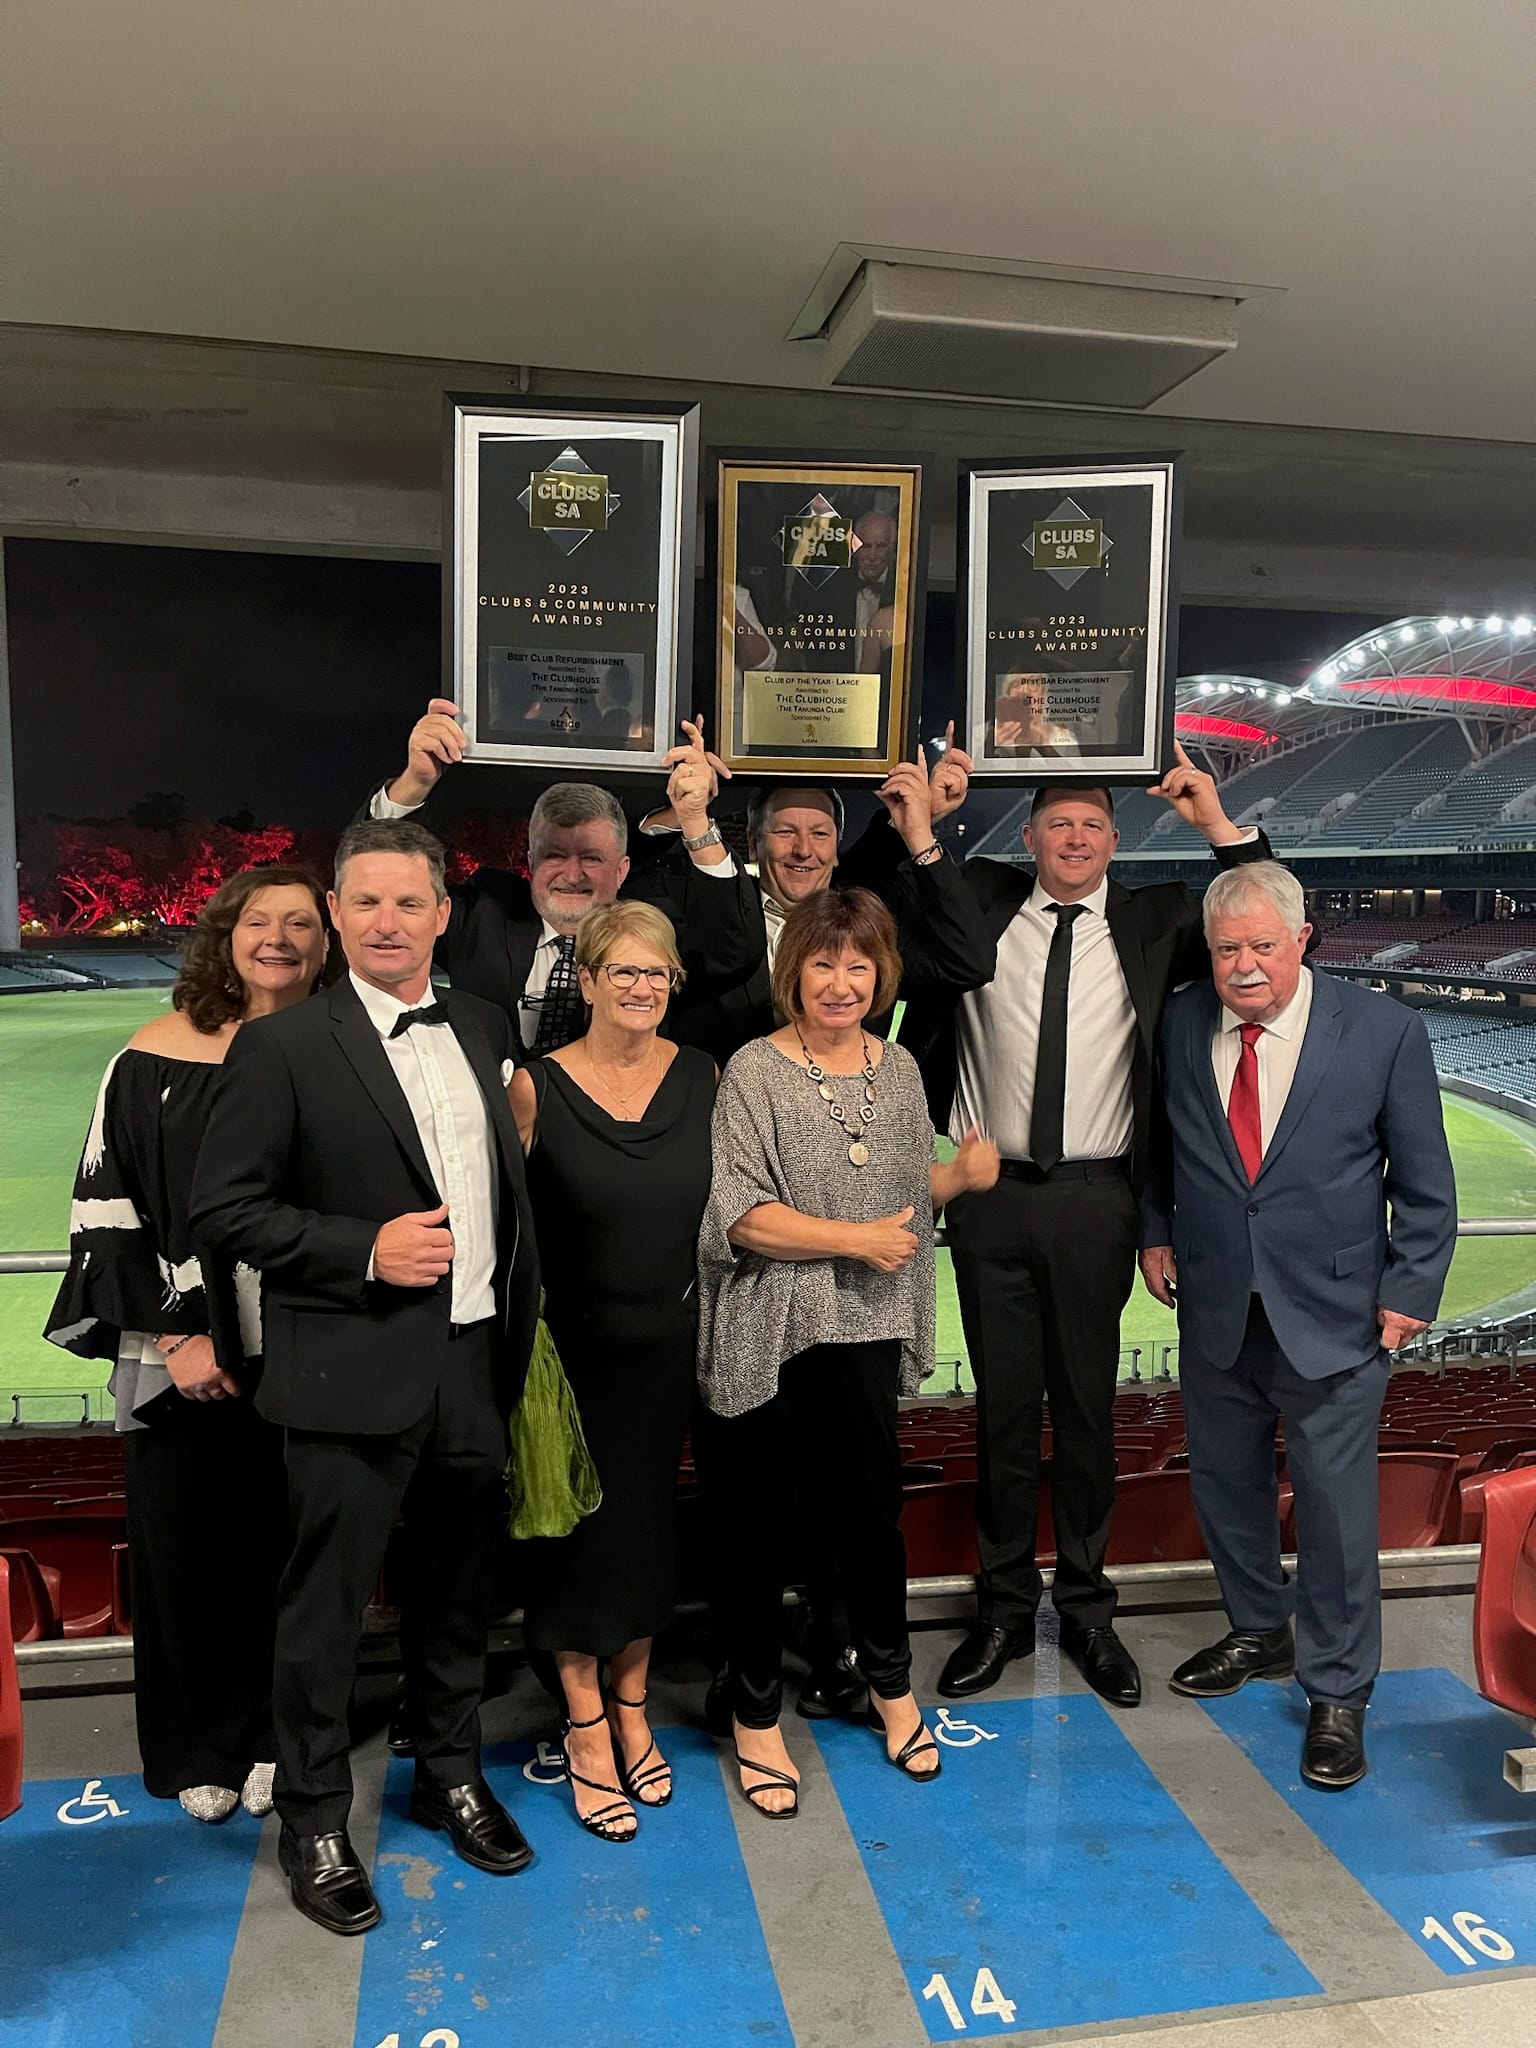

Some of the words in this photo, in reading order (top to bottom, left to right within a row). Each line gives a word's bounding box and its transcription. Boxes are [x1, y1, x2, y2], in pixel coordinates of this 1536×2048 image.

[537, 483, 600, 501] CLUBS
[554, 502, 581, 519] SA
[1040, 528, 1096, 545] CLUBS
[1055, 545, 1078, 560] SA
[548, 584, 589, 595] 2023
[479, 596, 532, 607] CLUBS
[539, 598, 547, 608] &
[554, 600, 656, 613] COMMUNITY
[531, 614, 603, 626] AWARDS
[798, 614, 834, 623] 2023
[1049, 615, 1086, 625] 2023
[736, 626, 784, 636] CLUBS
[790, 627, 797, 636] &
[803, 628, 893, 638] COMMUNITY
[988, 630, 1035, 640] CLUBS
[1041, 630, 1048, 638] &
[1055, 627, 1146, 638] COMMUNITY
[784, 641, 846, 650] AWARDS
[1035, 642, 1098, 651] AWARDS
[507, 652, 529, 662] BEST
[530, 654, 553, 663] CLUB
[555, 655, 625, 666] REFURBISHMENT
[532, 673, 548, 682] THE
[550, 674, 600, 684] CLUBHOUSE
[764, 676, 784, 684] CLUB
[812, 677, 831, 685] YEAR
[1057, 677, 1110, 685] ENVIRONMENT
[776, 694, 793, 703] THE
[795, 694, 848, 704] CLUBHOUSE
[1027, 696, 1045, 705] THE
[1047, 696, 1101, 704] CLUBHOUSE
[550, 718, 581, 729] stride
[1420, 1911, 1515, 1966] 16
[922, 1967, 1017, 2030] 14
